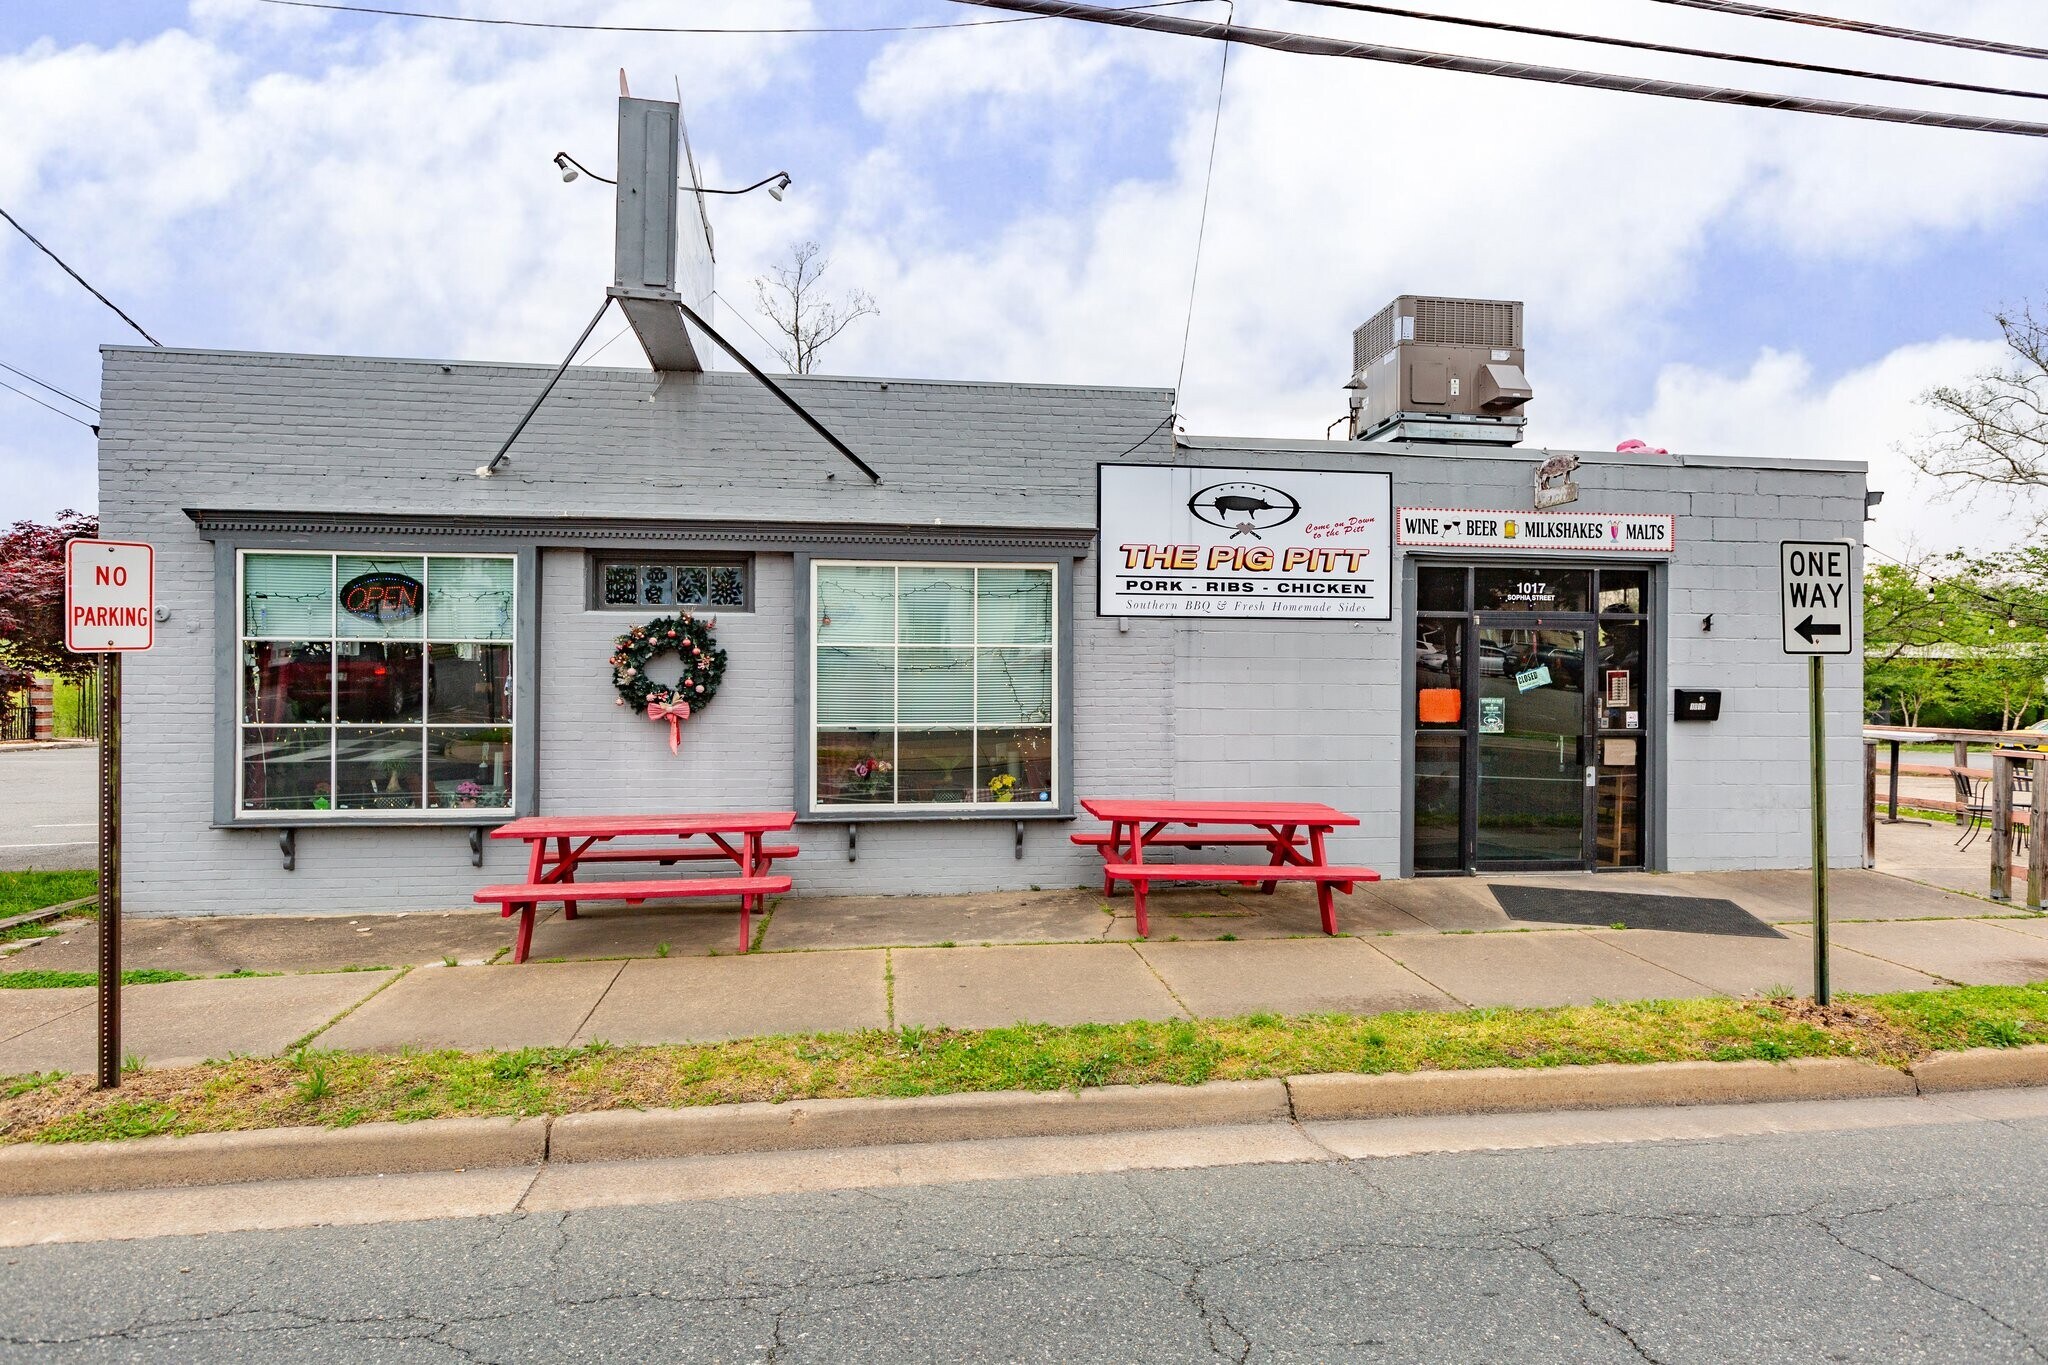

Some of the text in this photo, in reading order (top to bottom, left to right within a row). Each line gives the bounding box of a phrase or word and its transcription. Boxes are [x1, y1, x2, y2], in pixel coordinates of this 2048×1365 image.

[1305, 523, 1330, 534] Come
[1348, 516, 1375, 525] Down
[1326, 529, 1339, 537] the
[1344, 525, 1365, 534] Pitt
[1405, 518, 1665, 540] WINE BEER MILKSHAKES MALTS
[1120, 544, 1370, 573] THE PIG PITT
[1790, 551, 1841, 576] ONE
[95, 565, 127, 587] NO
[1126, 580, 1183, 592] PORK
[1206, 581, 1254, 593] RIBS
[1277, 583, 1366, 594] CHICKEN
[1516, 583, 1546, 594] 1017
[1789, 583, 1844, 608] WAY
[347, 585, 418, 612] OPEN
[1126, 599, 1366, 613] Southern BBQ & Fresh Homemade Sides
[74, 606, 148, 627] PARKING
[1518, 671, 1538, 684] CLOSED
